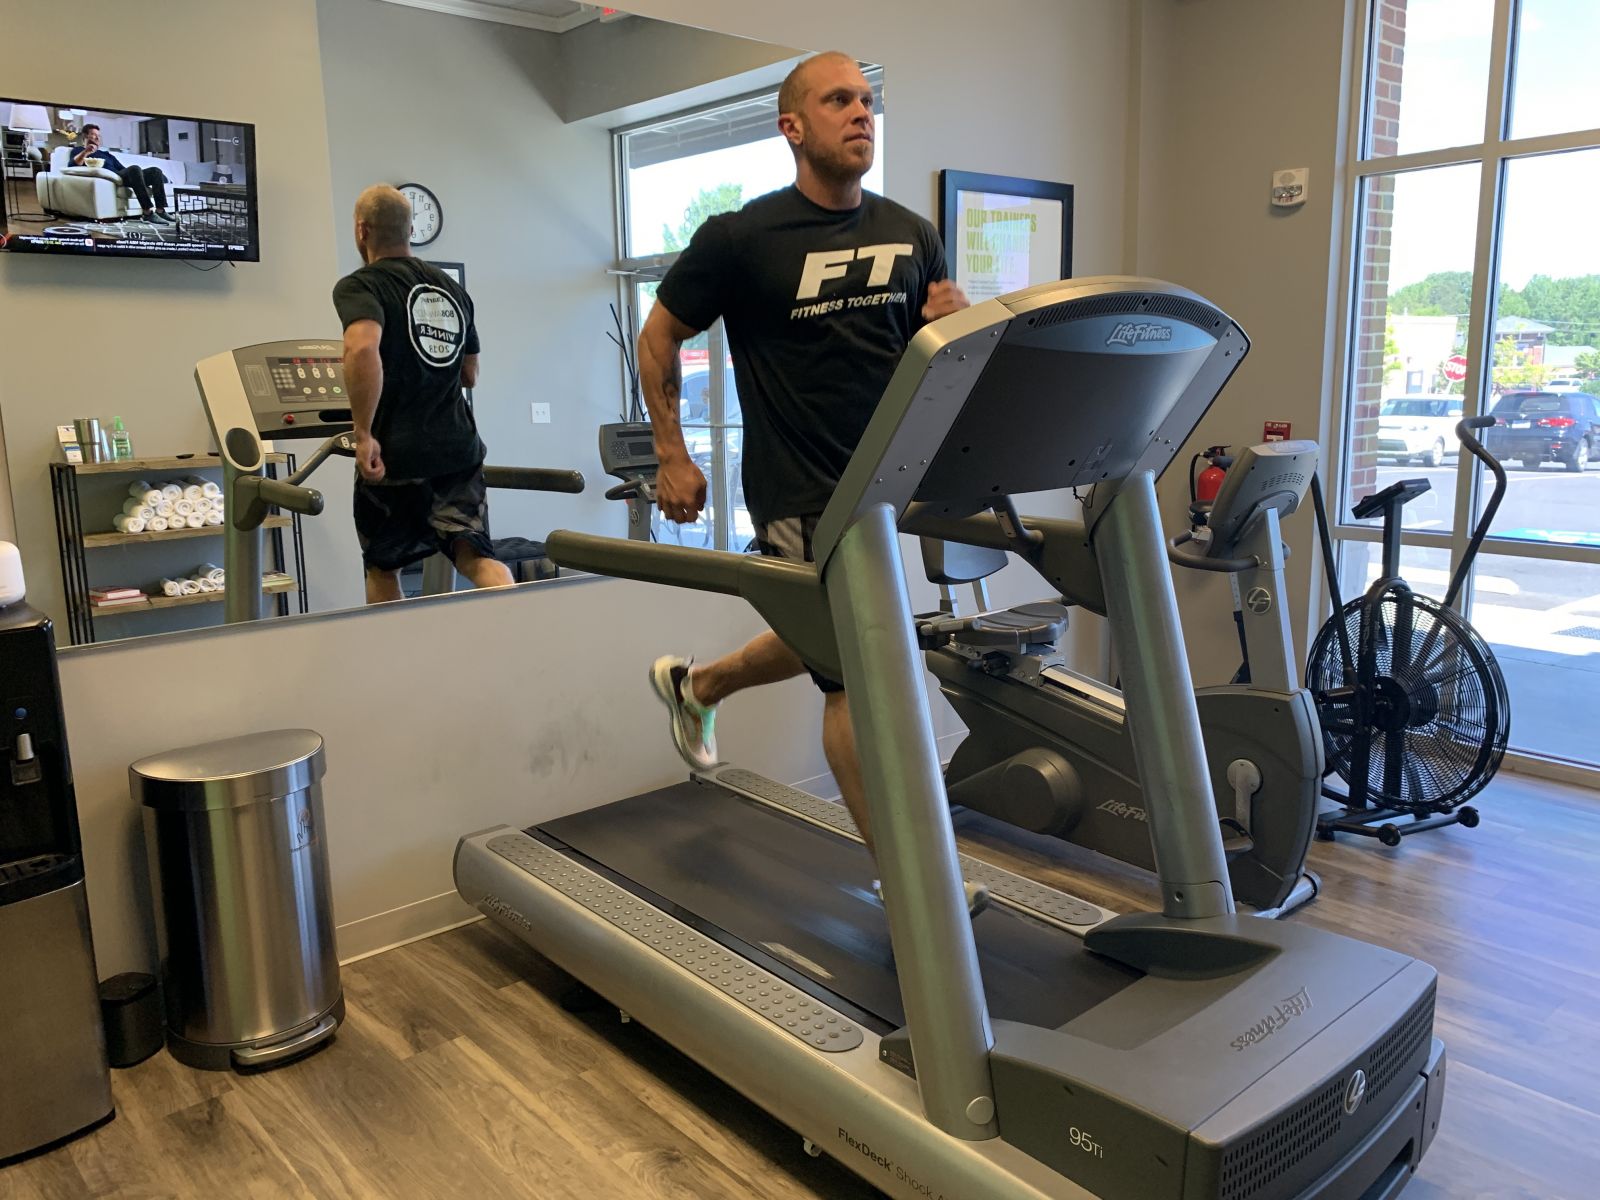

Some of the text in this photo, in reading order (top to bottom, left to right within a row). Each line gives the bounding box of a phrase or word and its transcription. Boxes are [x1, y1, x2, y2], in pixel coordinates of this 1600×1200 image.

[967, 208, 1037, 233] OUR TRAINERS
[967, 231, 989, 251] WILL
[796, 243, 914, 301] FT
[966, 254, 992, 273] YOUR
[790, 292, 908, 320] FITNESS TOGETHER
[1105, 323, 1171, 345] LifeFitness
[1069, 1126, 1104, 1160] 95Ti
[837, 1127, 934, 1200] FlexDeck Shock
